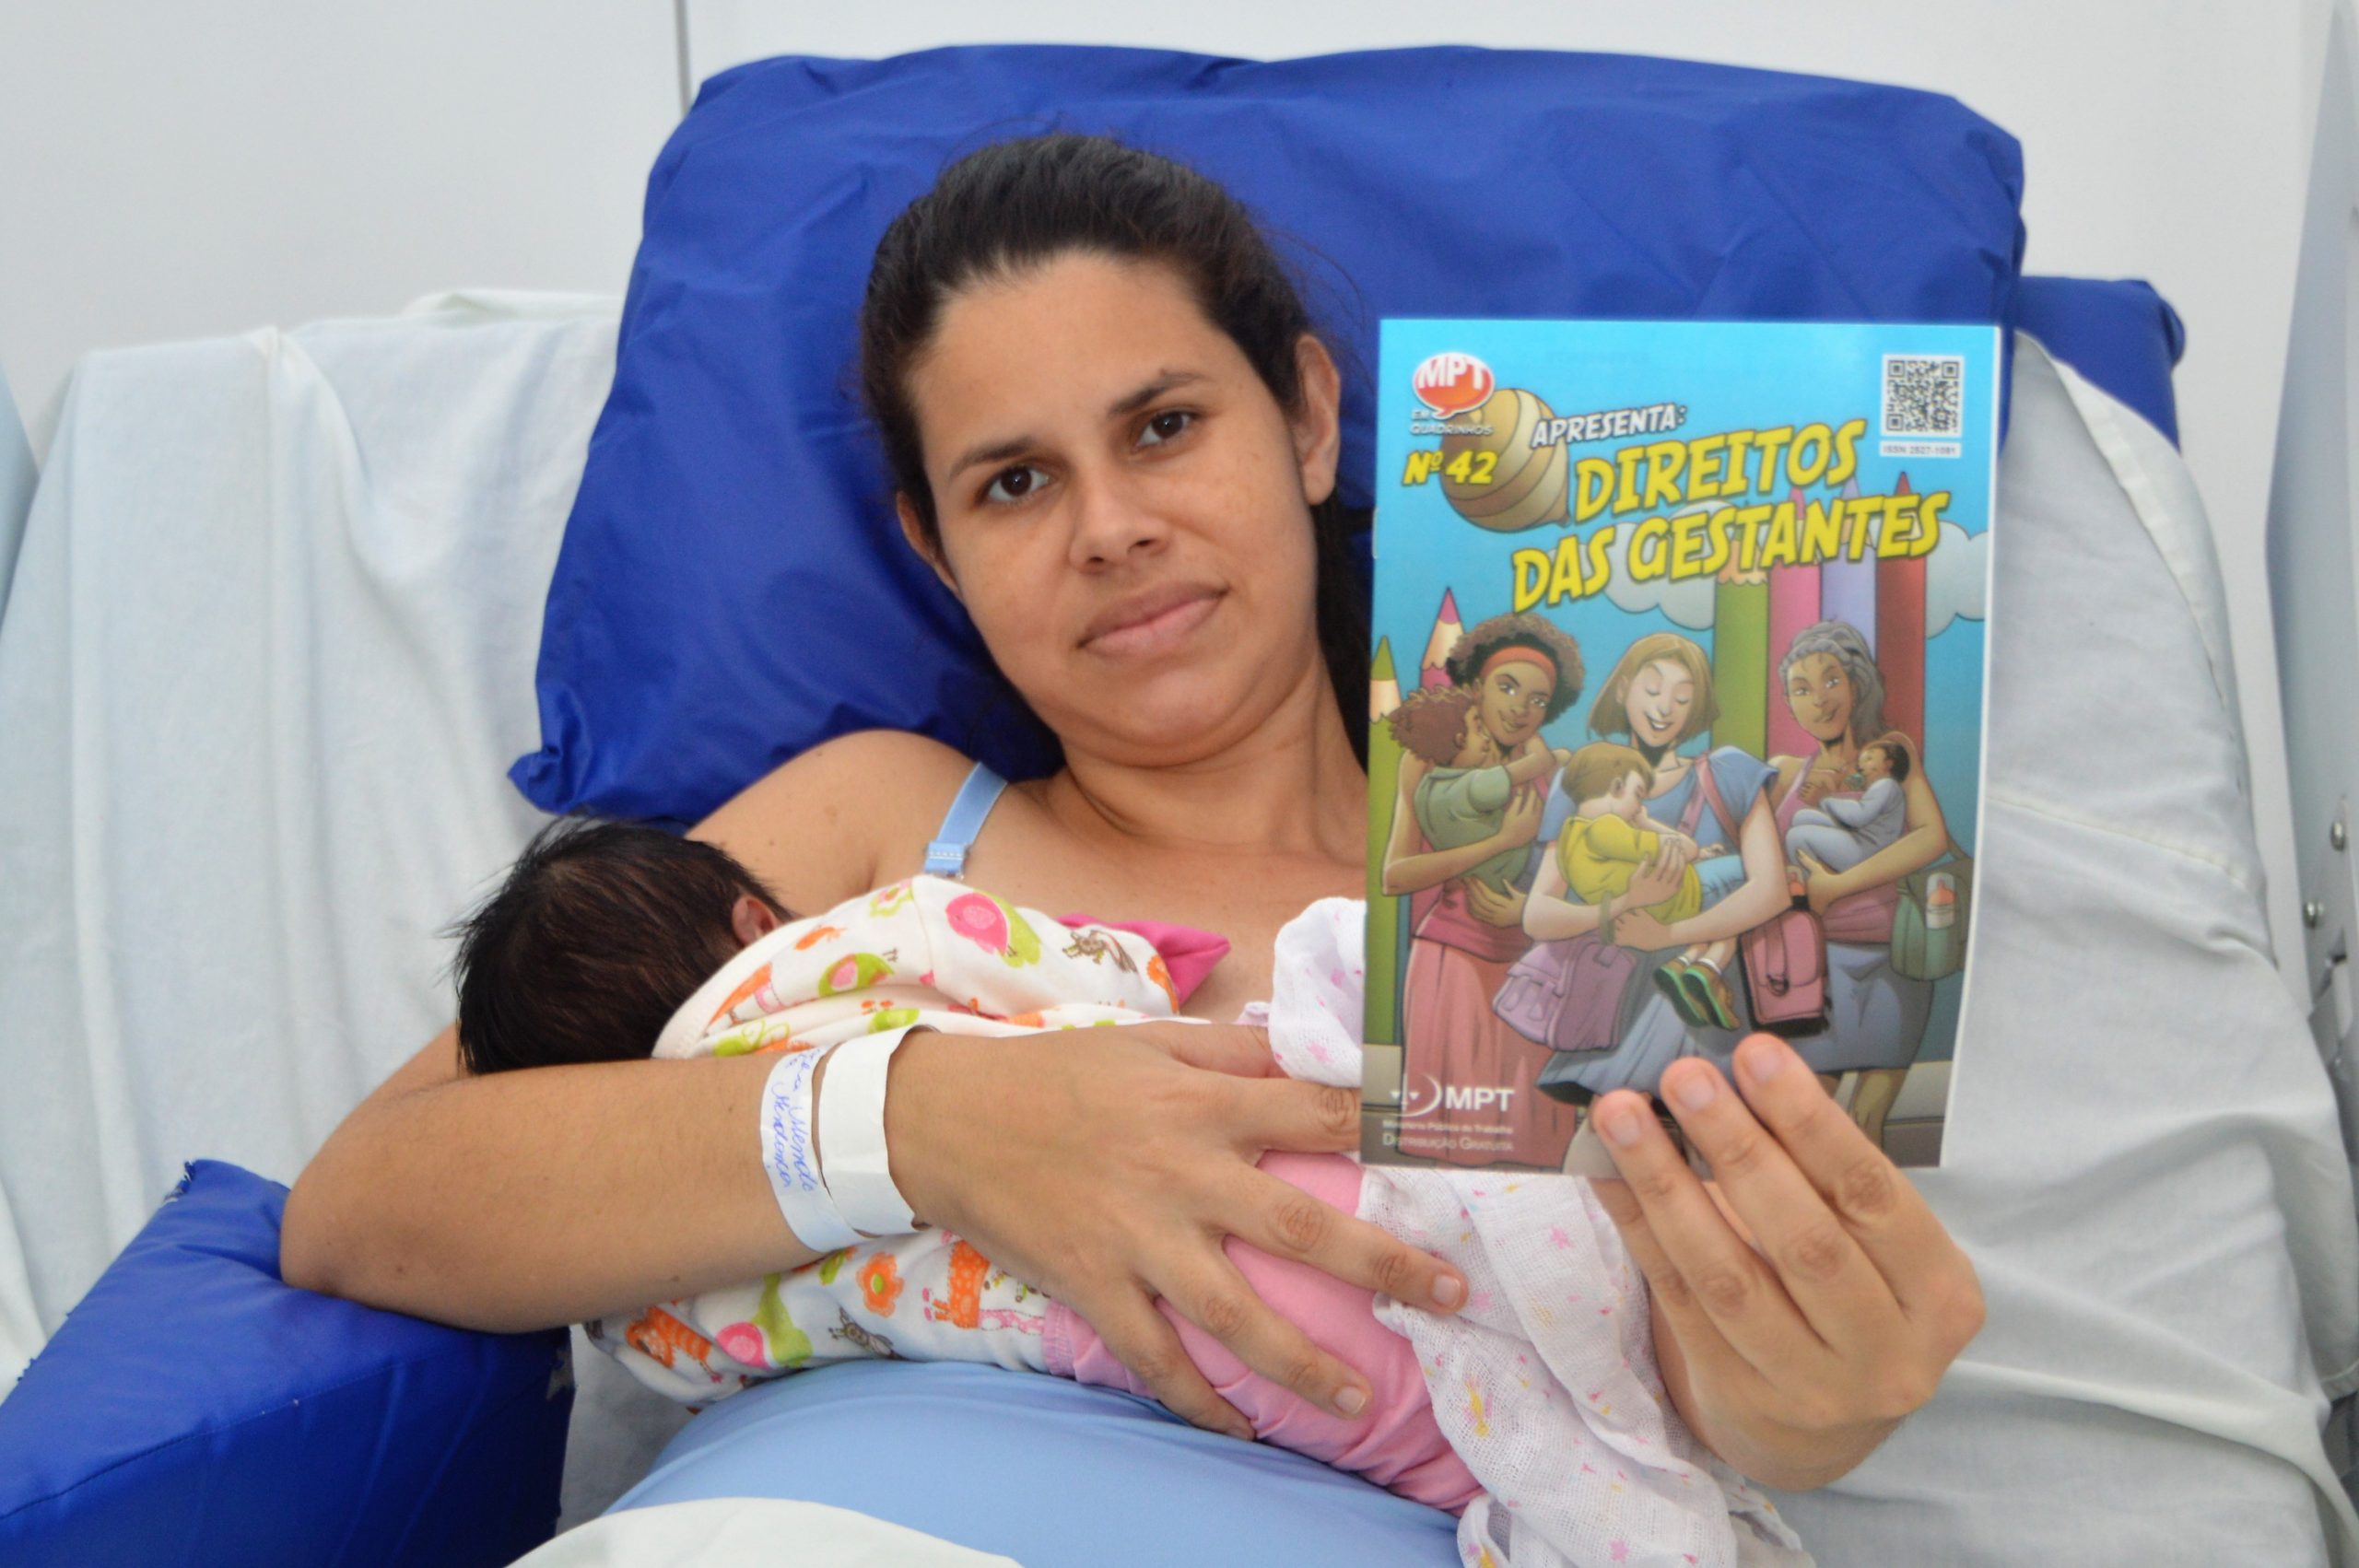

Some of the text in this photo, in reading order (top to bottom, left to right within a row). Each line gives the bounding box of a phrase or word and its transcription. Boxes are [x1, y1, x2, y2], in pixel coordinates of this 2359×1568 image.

[1416, 355, 1488, 391] MPT
[1530, 403, 1687, 450] APRESENTA:
[1445, 449, 1498, 485] 42
[1574, 419, 1868, 524] DIREITOS
[1511, 490, 1952, 614] DAS GESTANTES
[1445, 1086, 1516, 1112] MPT
